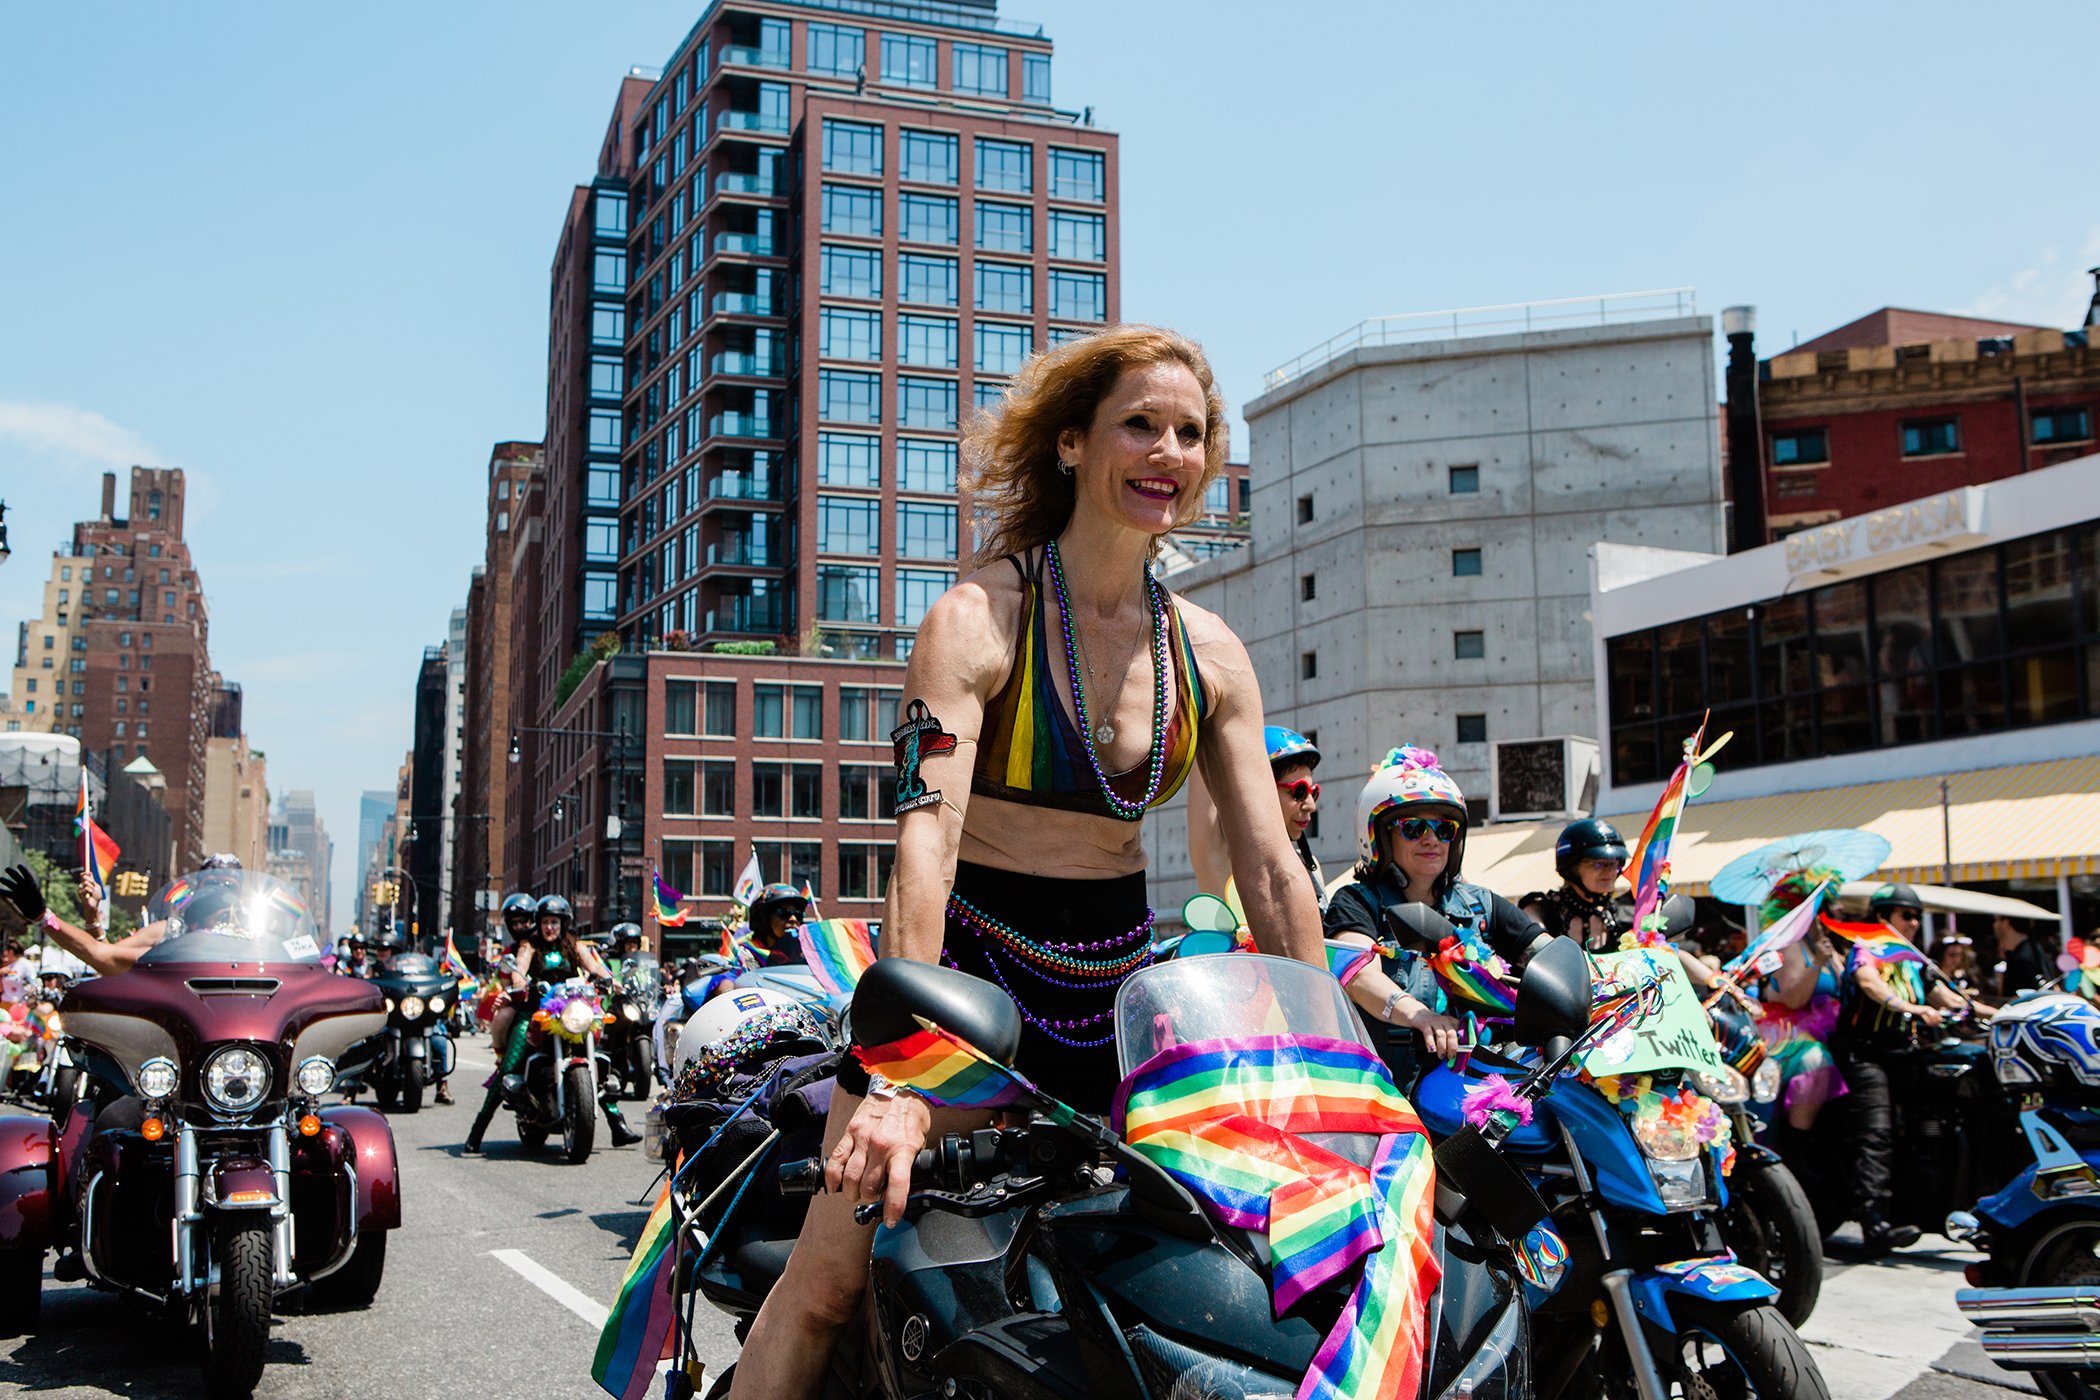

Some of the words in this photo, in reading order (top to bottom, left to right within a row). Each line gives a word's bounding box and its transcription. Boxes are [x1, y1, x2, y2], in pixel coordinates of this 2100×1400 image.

[1784, 523, 1859, 574] BABY
[1867, 495, 1966, 552] BRASA
[1637, 1028, 1718, 1067] Twitter
